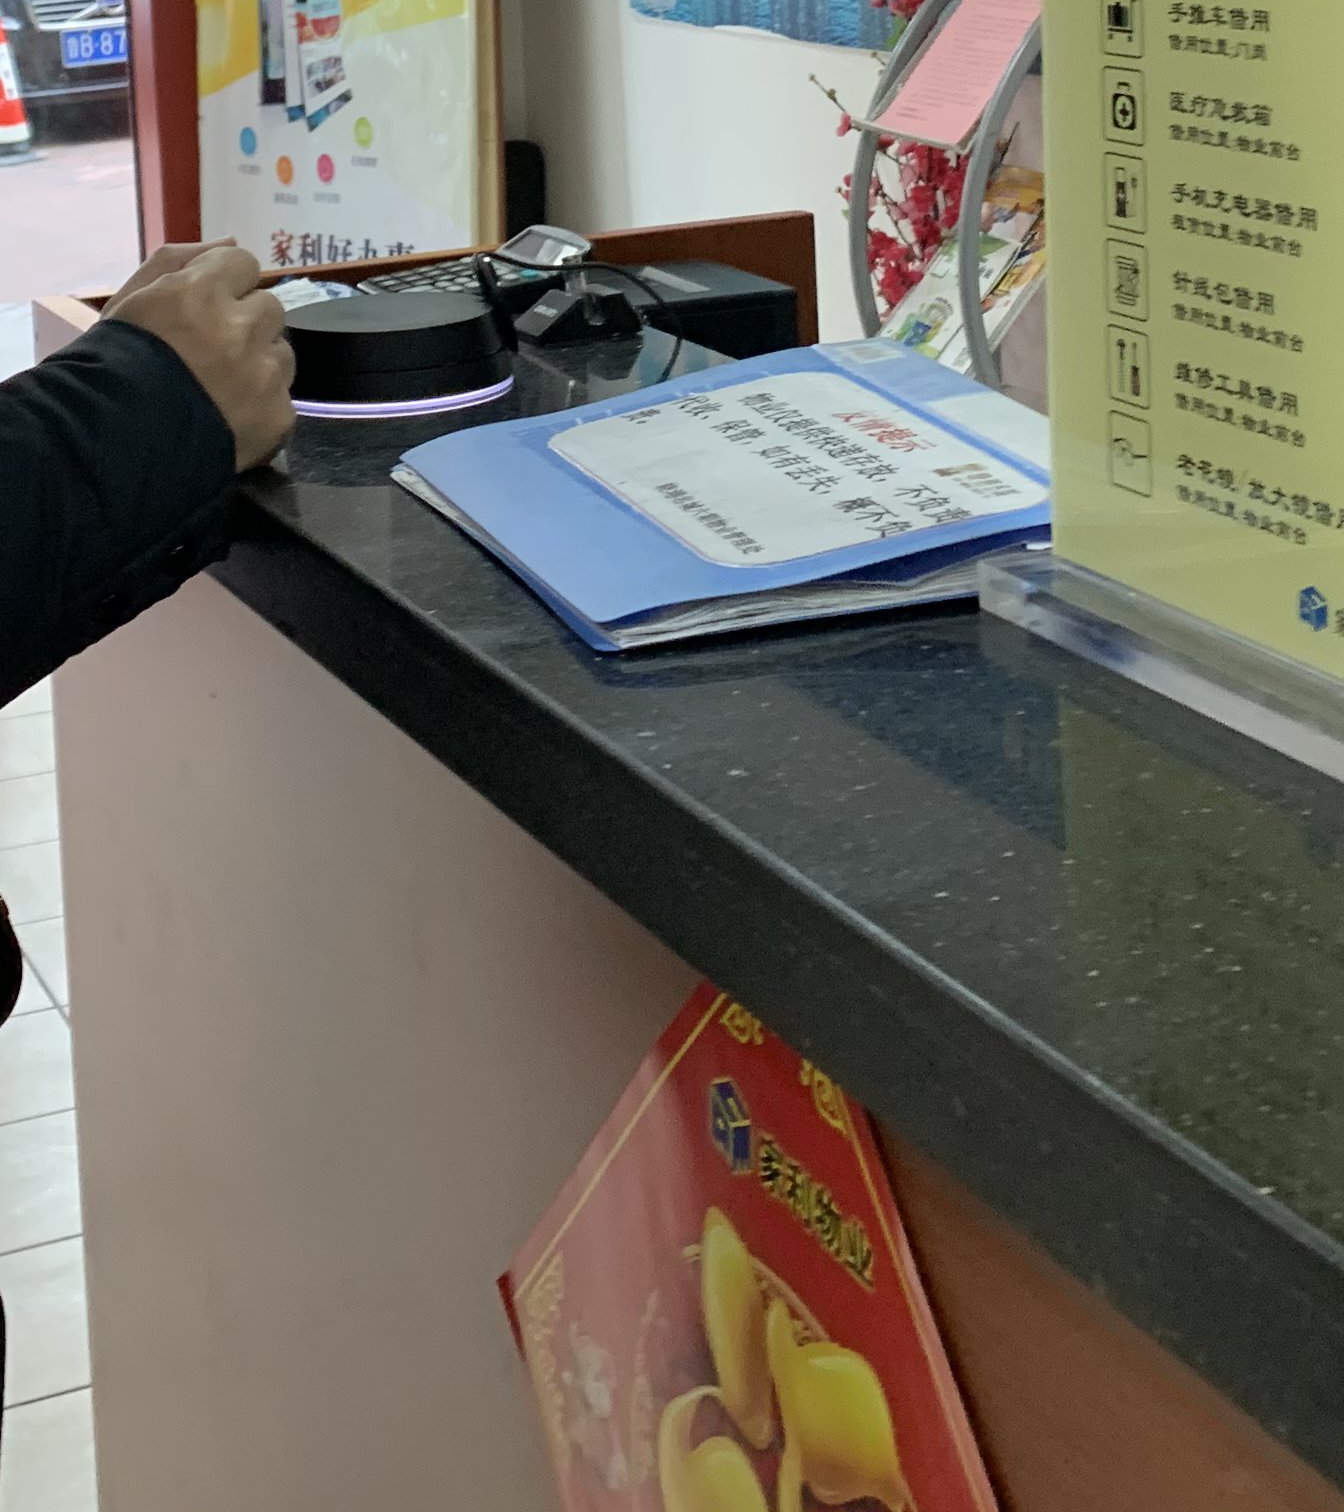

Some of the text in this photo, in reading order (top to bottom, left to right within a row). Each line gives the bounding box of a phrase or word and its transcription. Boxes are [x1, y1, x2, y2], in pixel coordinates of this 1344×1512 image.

[1168, 2, 1271, 32] 手推车借用
[1175, 362, 1300, 417] 维修工具借用
